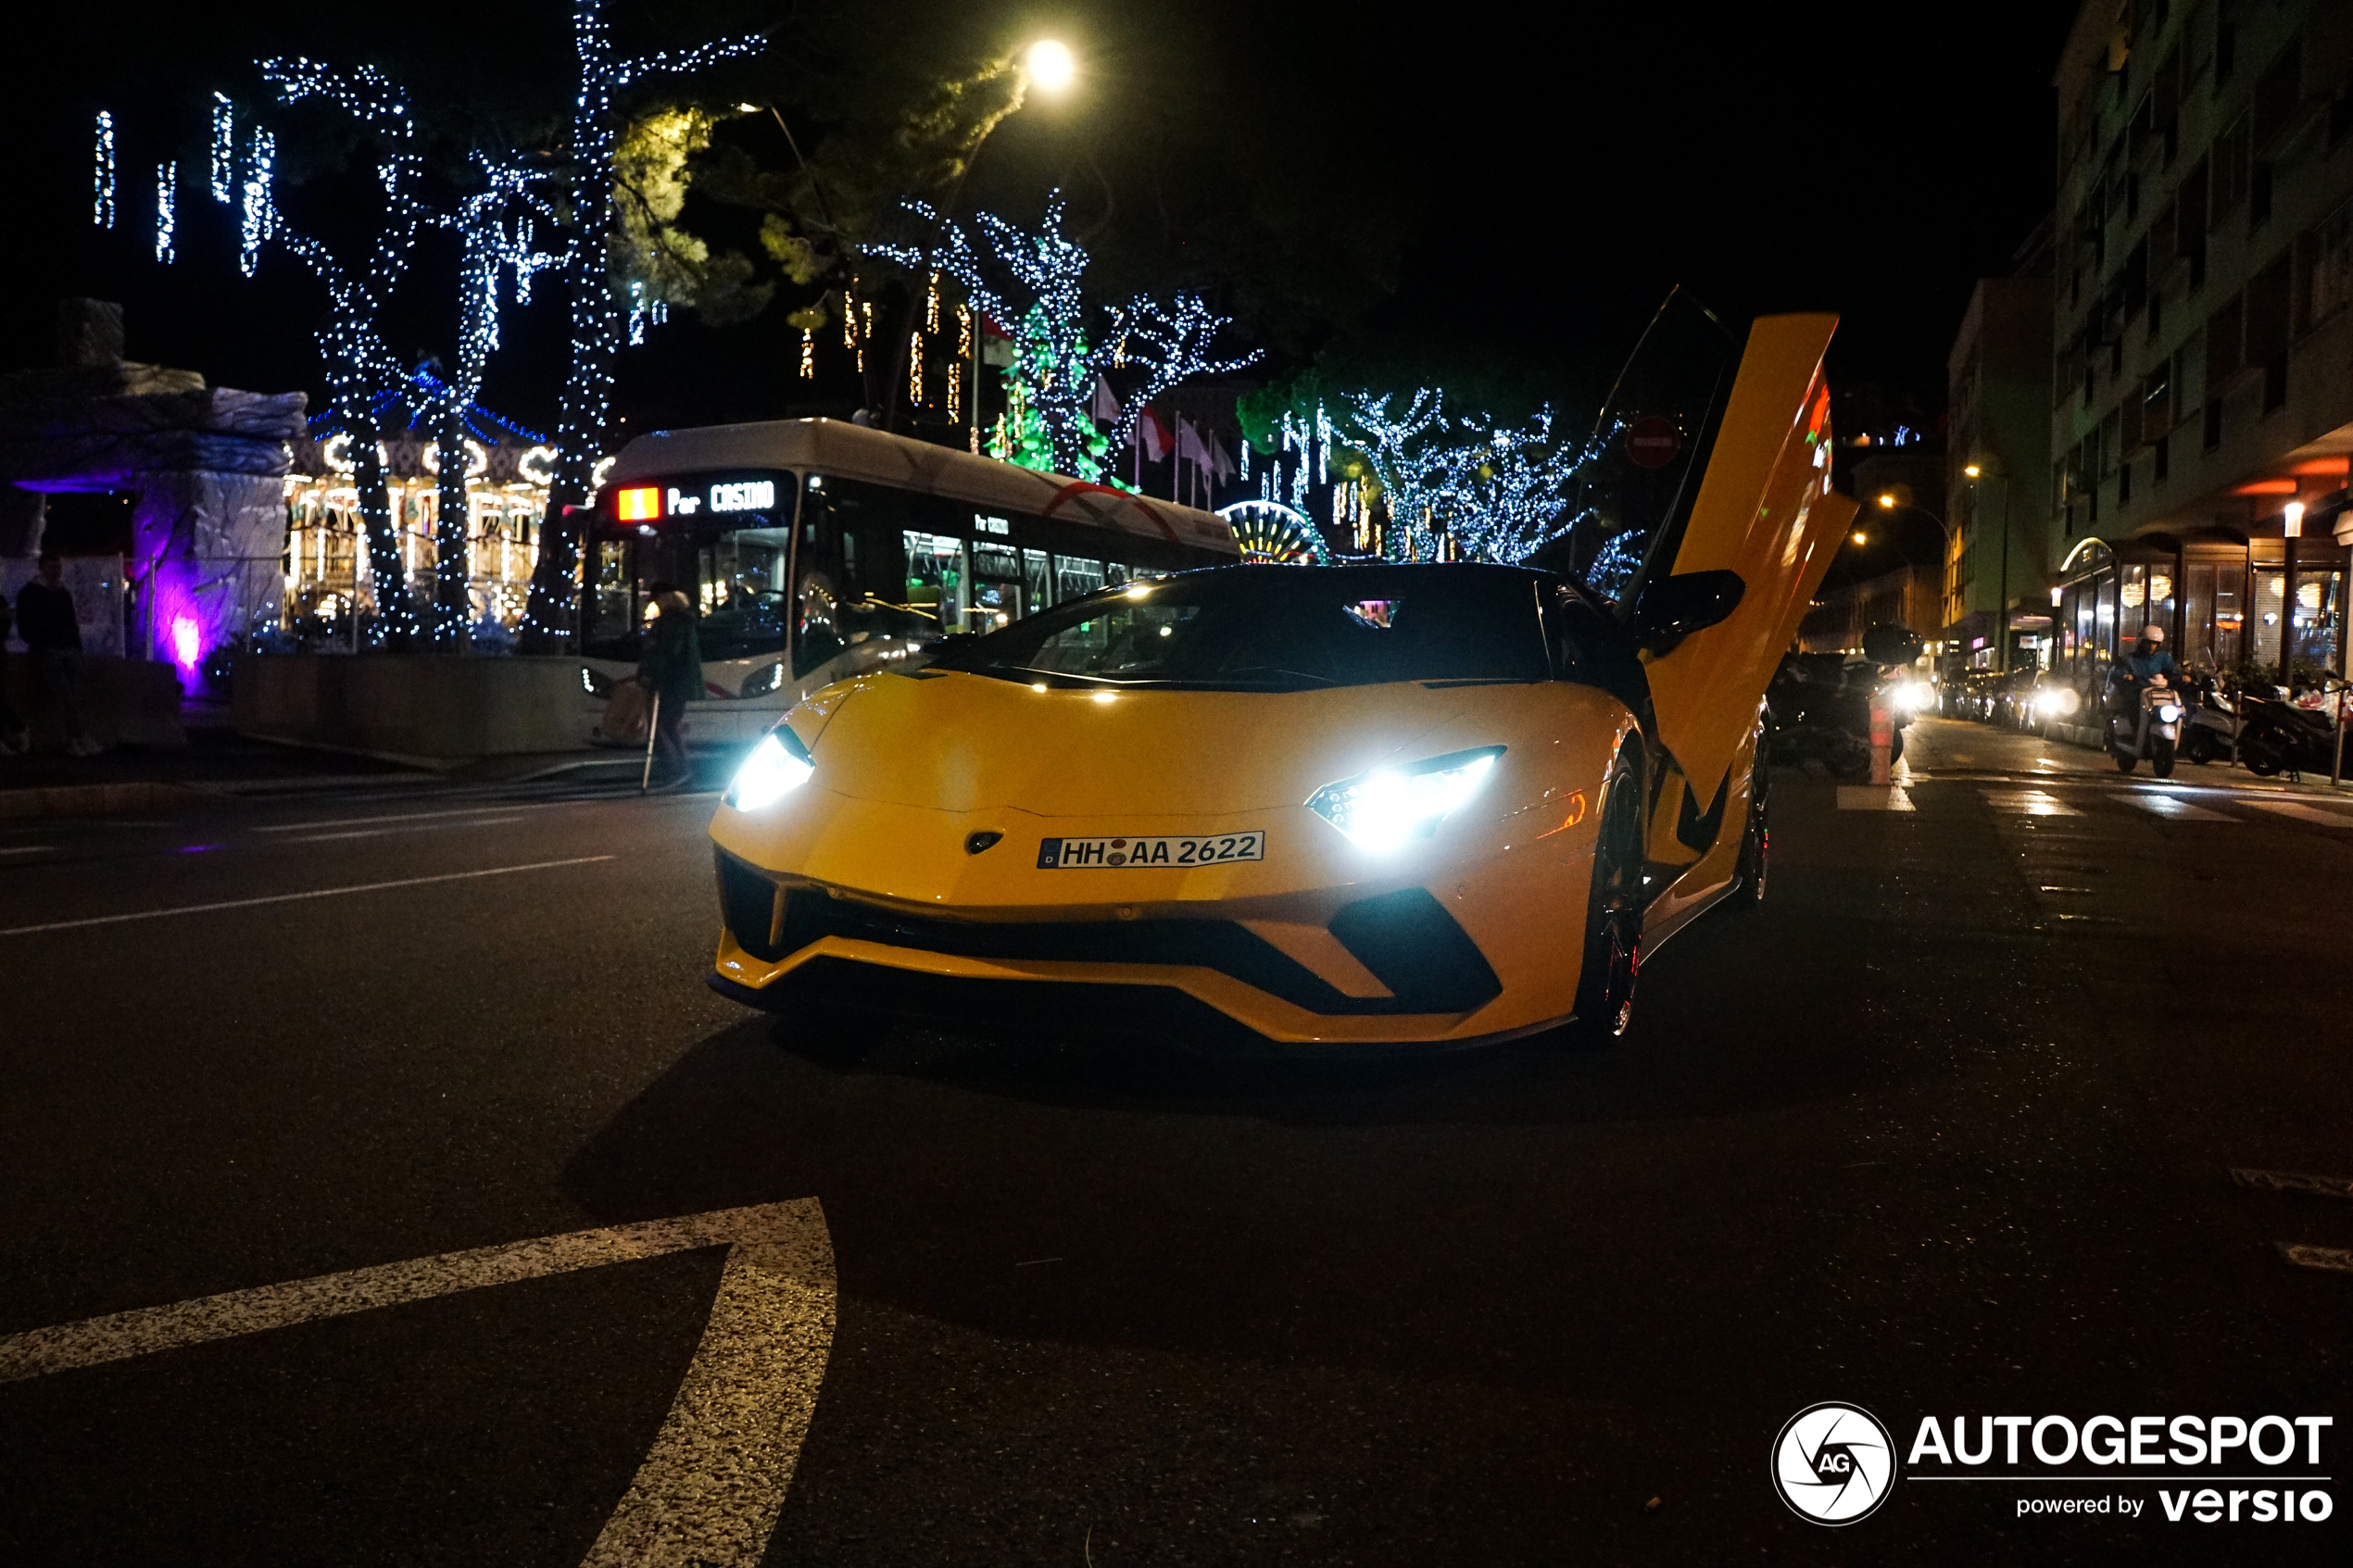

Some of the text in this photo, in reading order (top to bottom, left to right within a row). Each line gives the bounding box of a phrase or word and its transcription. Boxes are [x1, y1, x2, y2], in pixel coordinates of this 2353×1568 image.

[667, 487, 701, 516] Par
[710, 480, 774, 513] CASINO
[1044, 856, 1054, 864] D
[1063, 835, 1256, 864] HH AA 2622
